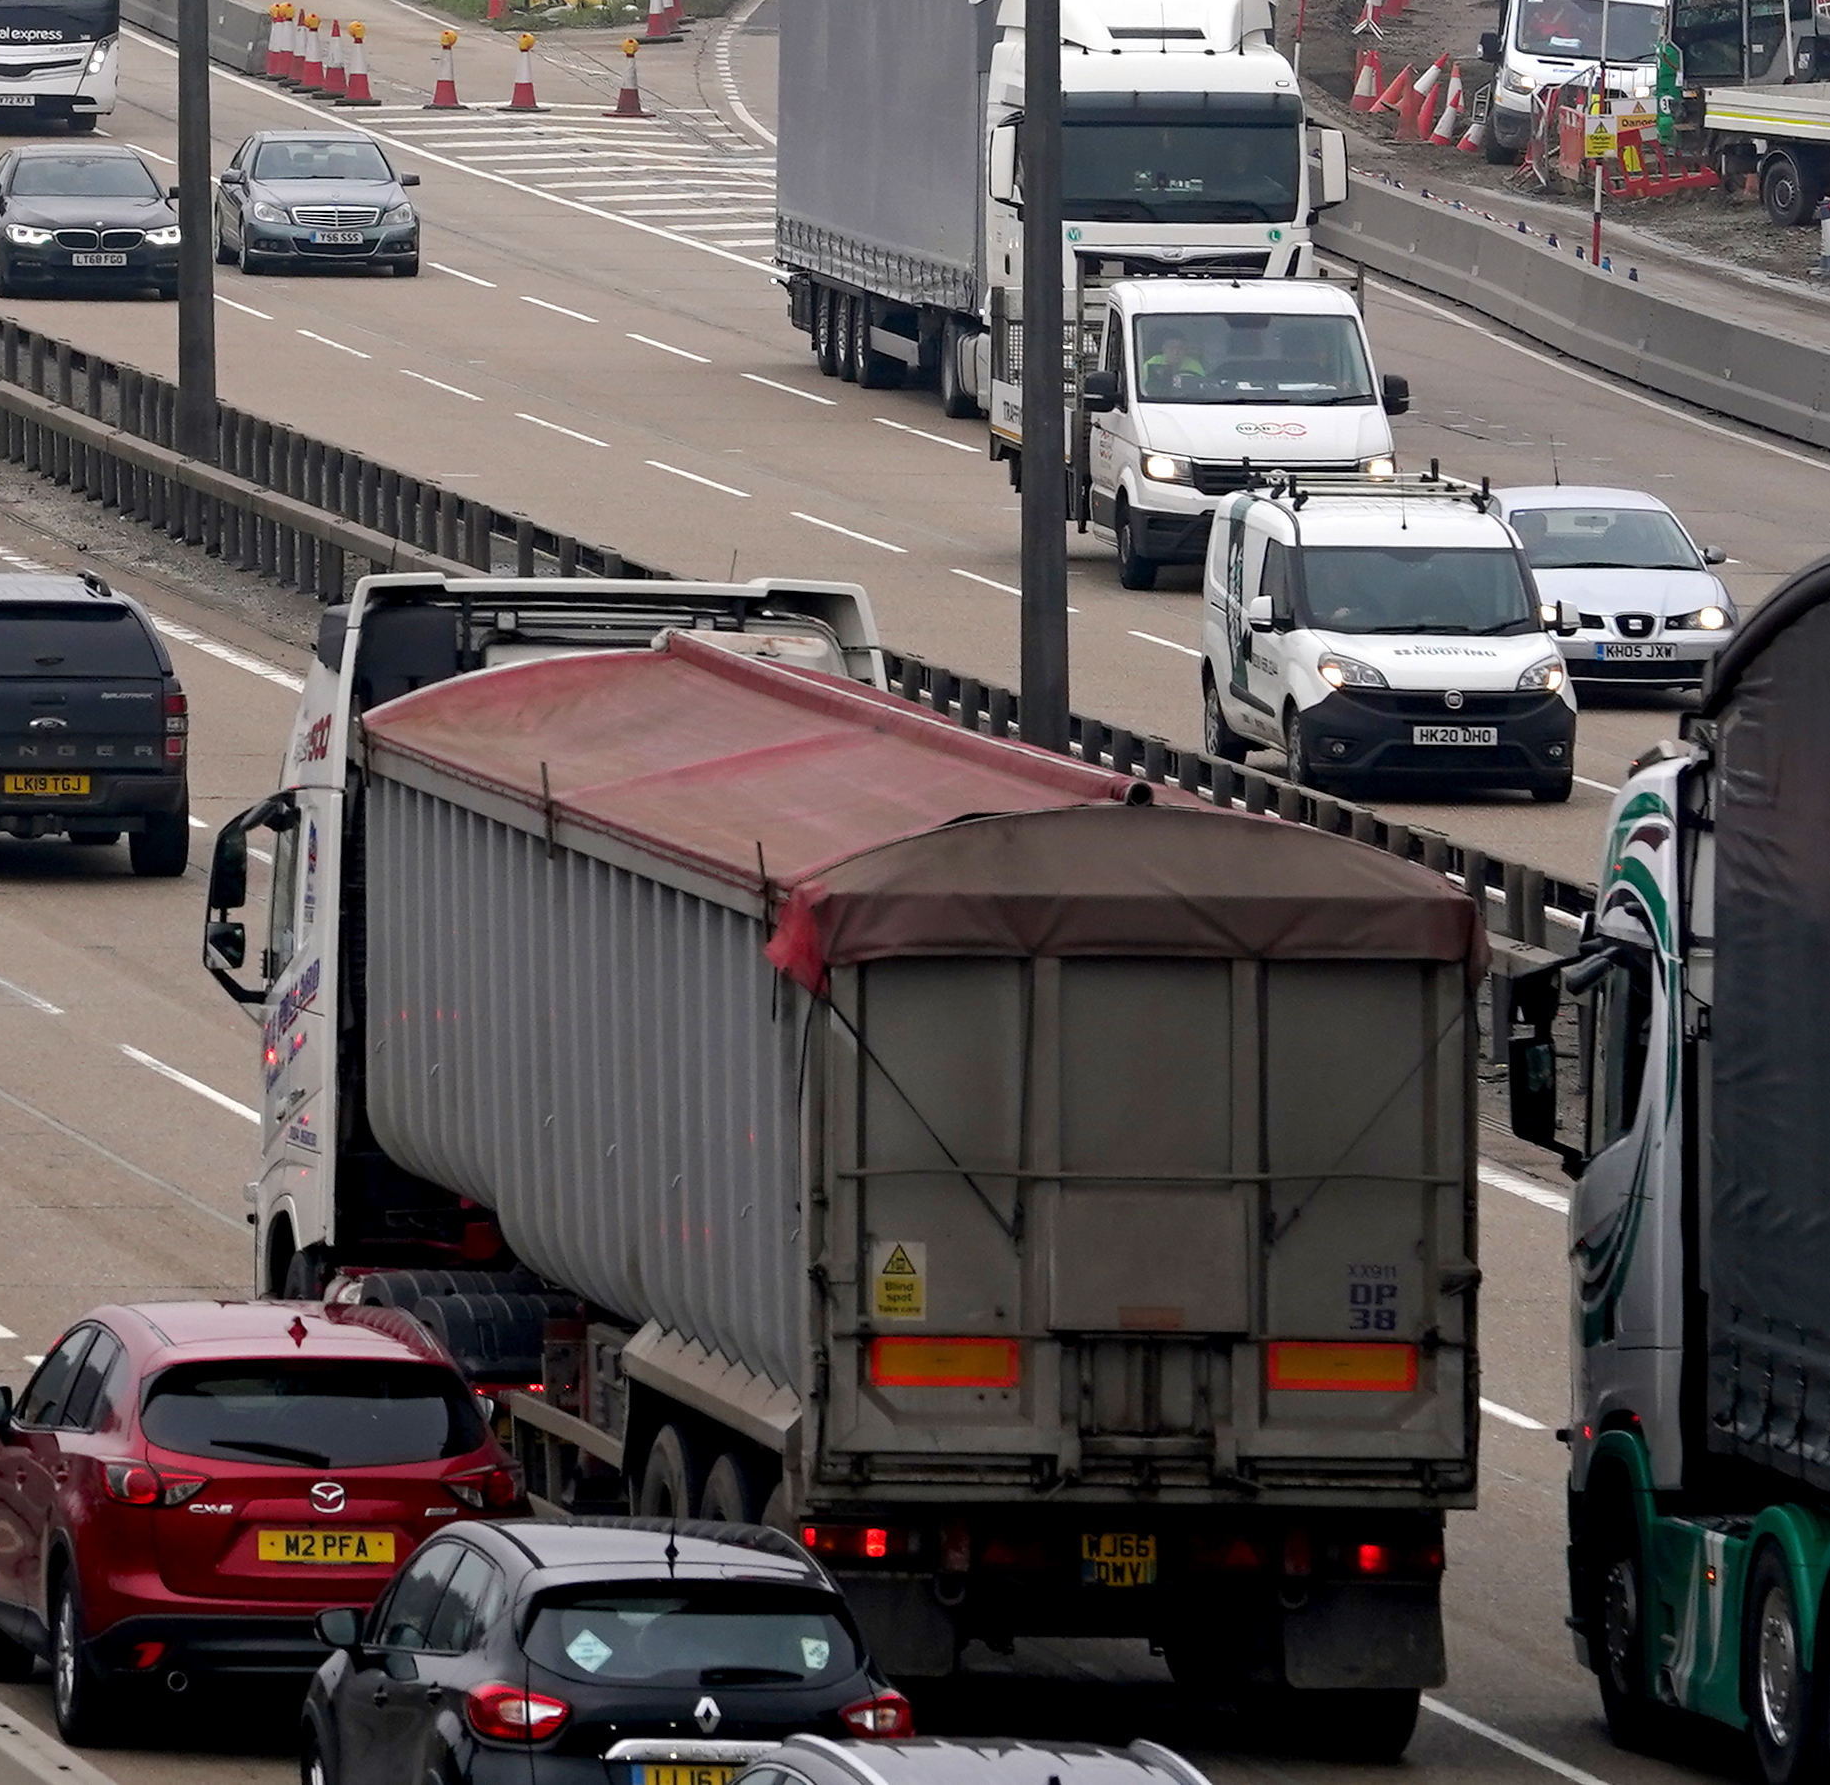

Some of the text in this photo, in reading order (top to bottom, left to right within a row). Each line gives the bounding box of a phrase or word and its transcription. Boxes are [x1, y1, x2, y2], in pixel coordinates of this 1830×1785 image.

[11, 29, 63, 42] express
[341, 233, 359, 242] SSS
[1606, 644, 1673, 658] KH05 JXW
[1420, 728, 1458, 743] HK20
[13, 777, 81, 791] LK19 TGJ
[885, 1282, 913, 1292] Blind
[886, 1294, 912, 1303] spot
[1350, 1284, 1397, 1305] DP
[1349, 1308, 1395, 1330] 38
[285, 1535, 369, 1558] M2 PFA
[1085, 1534, 1151, 1558] WJ66
